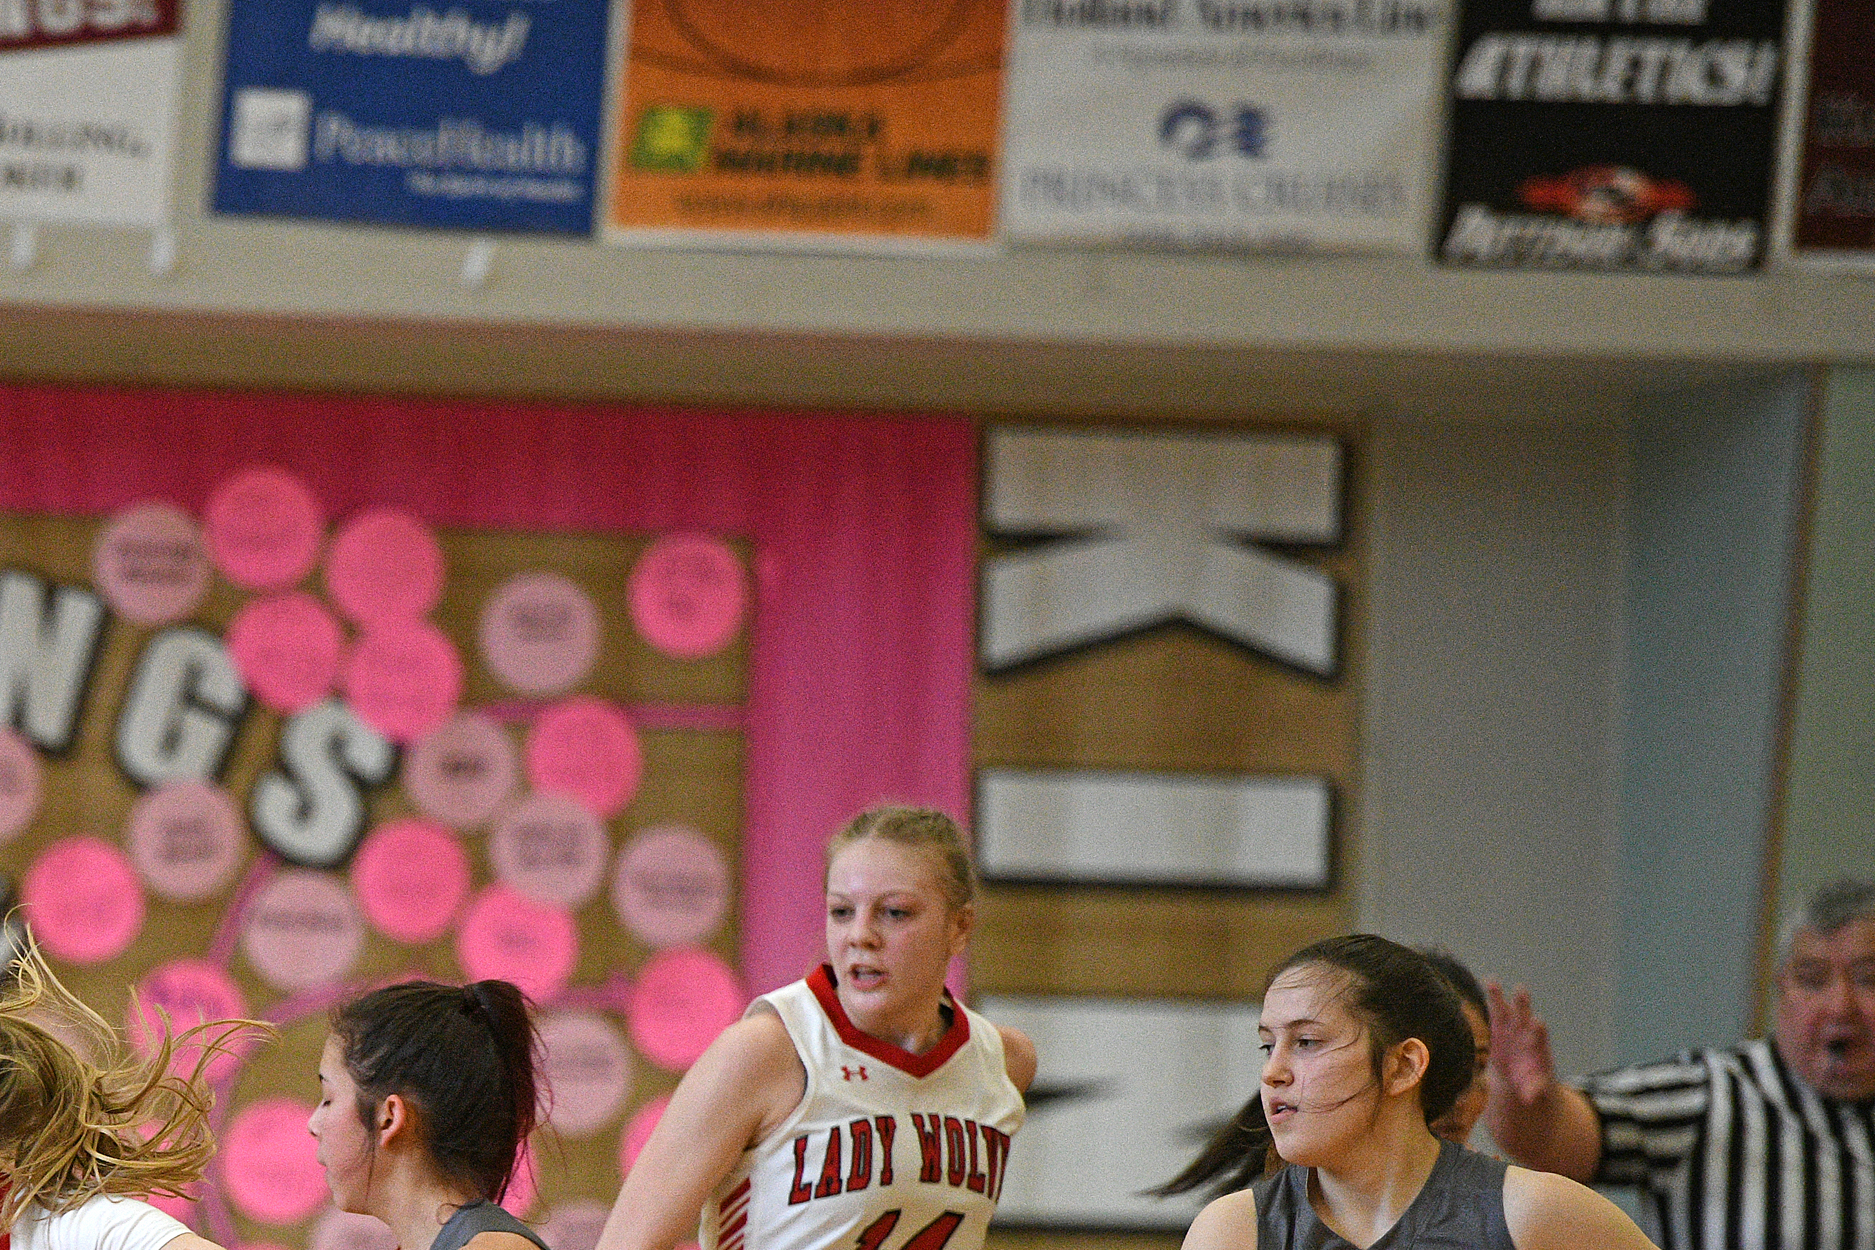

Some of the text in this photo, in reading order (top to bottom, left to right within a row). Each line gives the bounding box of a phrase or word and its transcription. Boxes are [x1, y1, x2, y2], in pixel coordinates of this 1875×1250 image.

[309, 8, 527, 72] Healthy!
[1457, 33, 1777, 107] ATHLETICS!
[788, 1115, 897, 1206] LADY
